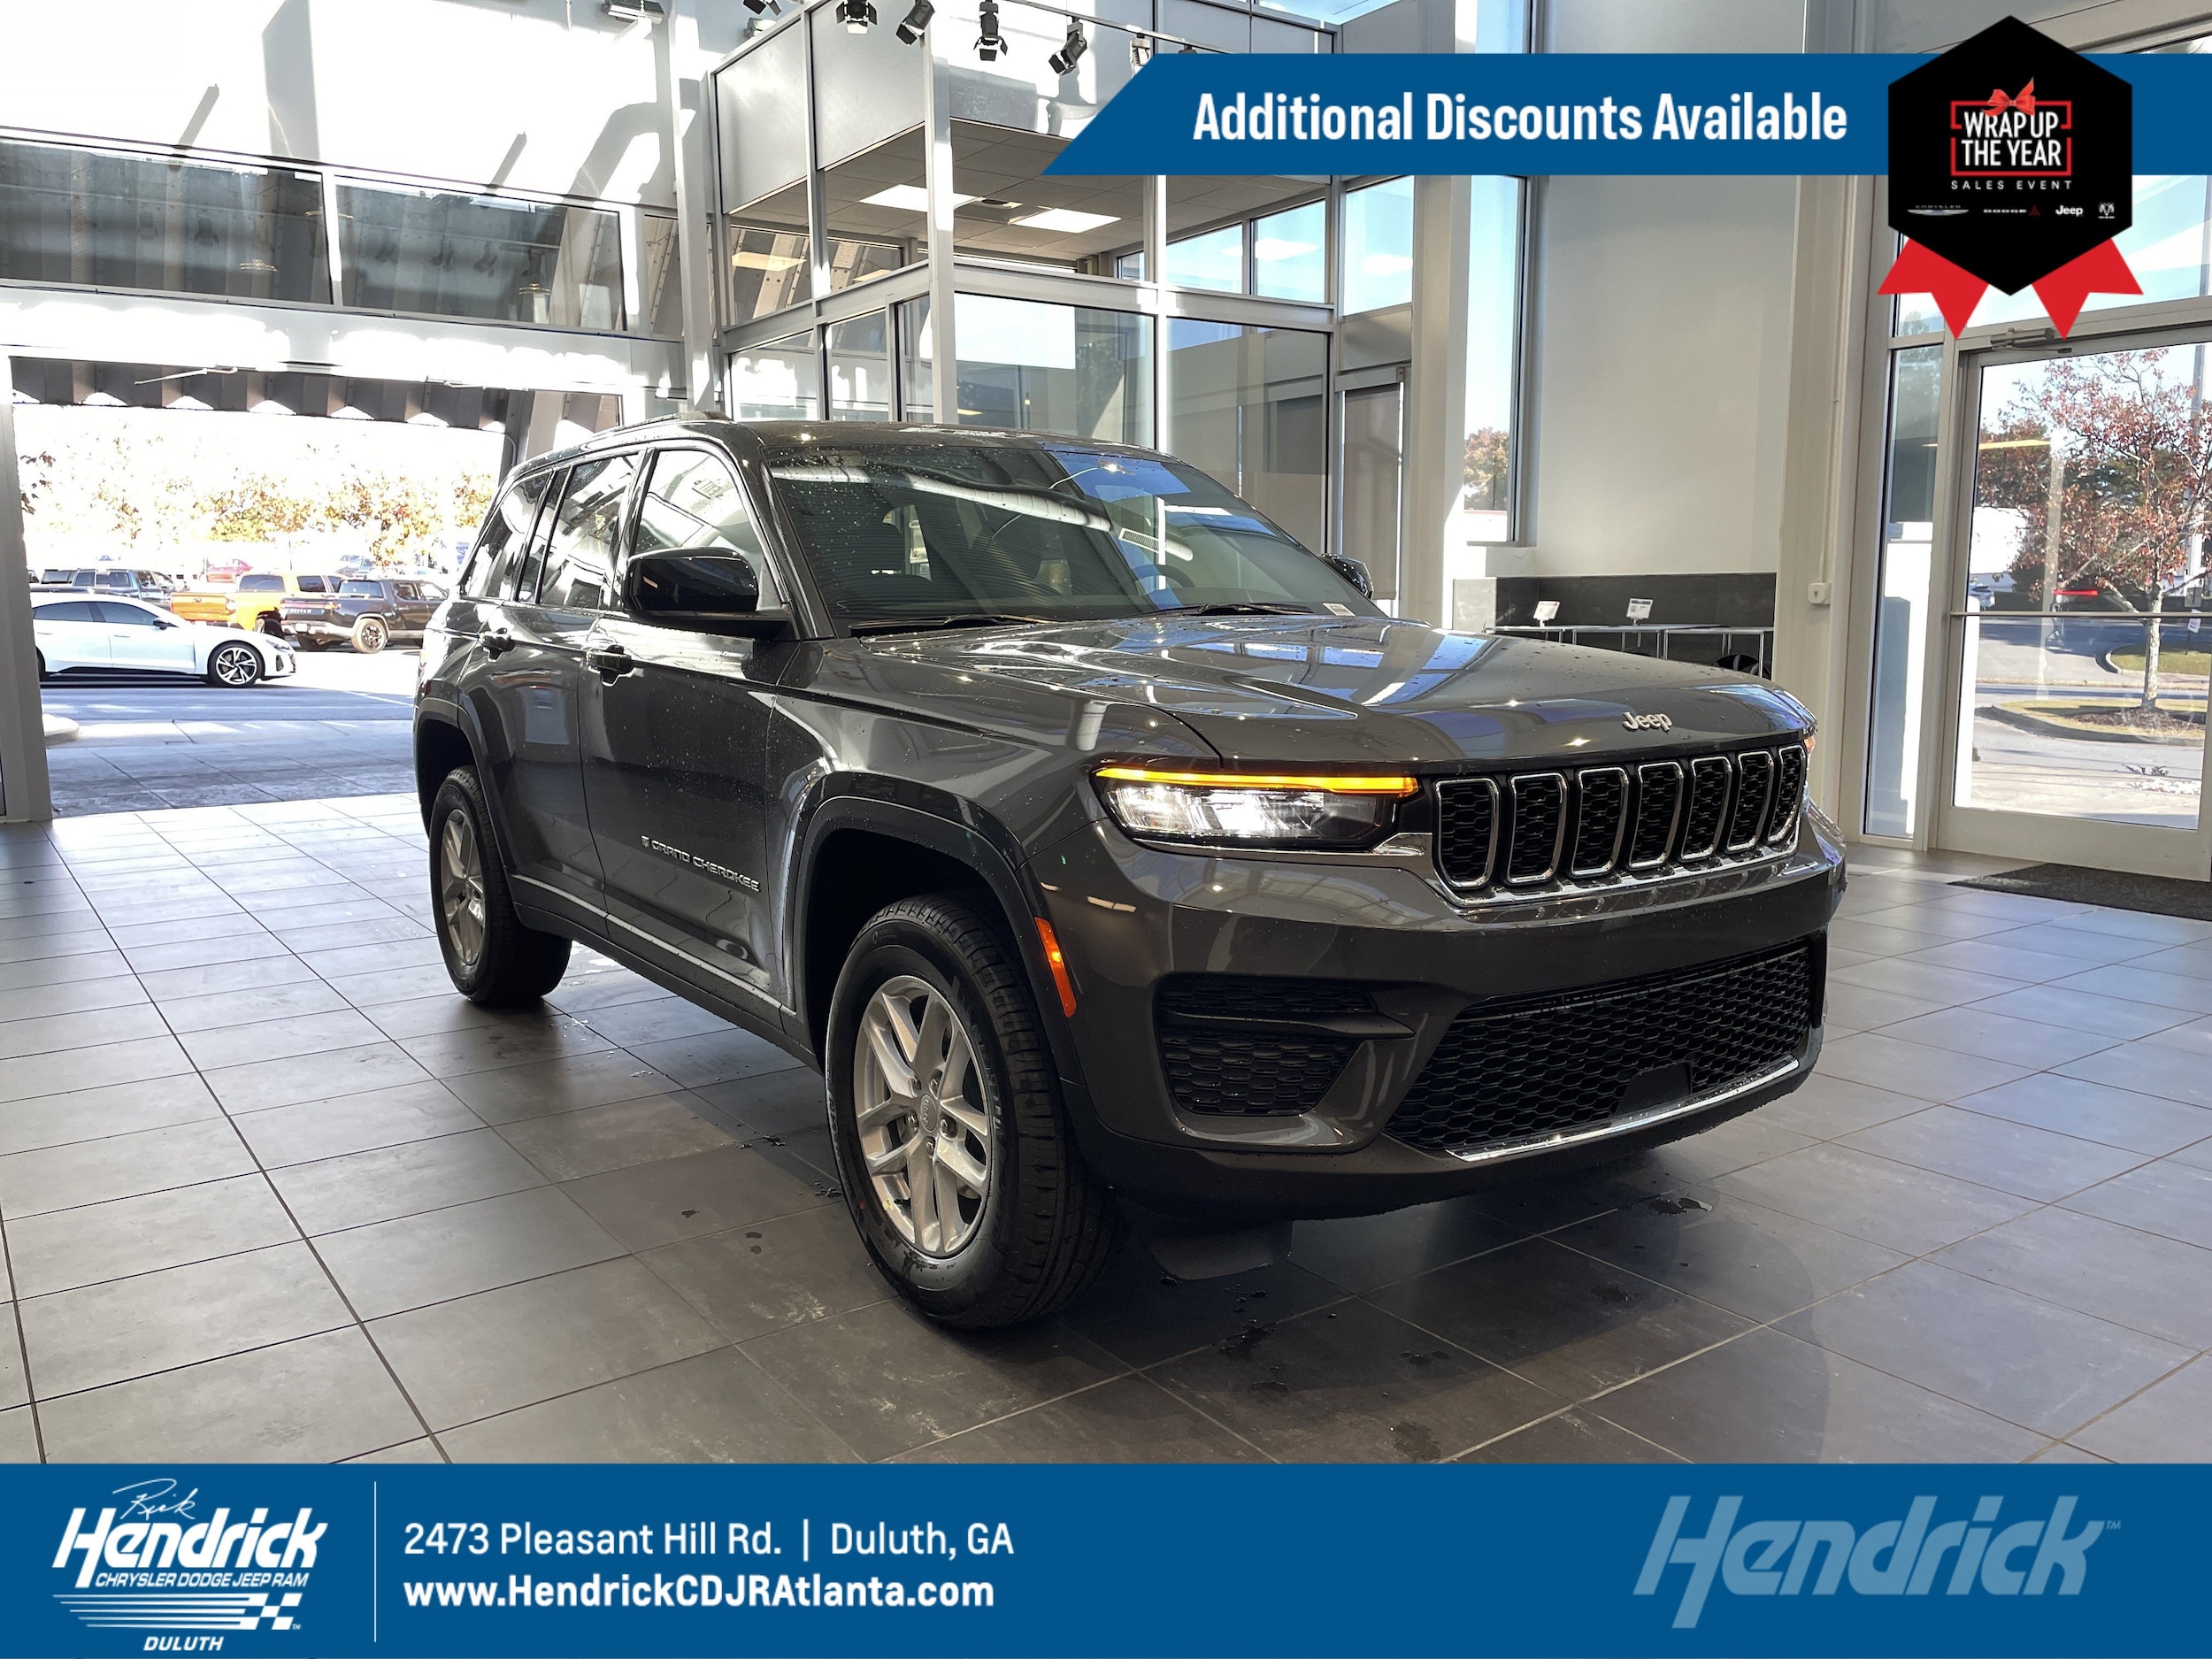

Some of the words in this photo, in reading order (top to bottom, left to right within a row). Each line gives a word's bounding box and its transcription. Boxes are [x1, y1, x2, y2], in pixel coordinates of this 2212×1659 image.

[1622, 711, 1673, 732] Jeep
[651, 841, 690, 863] GRAND
[693, 856, 761, 892] CHEROKEE
